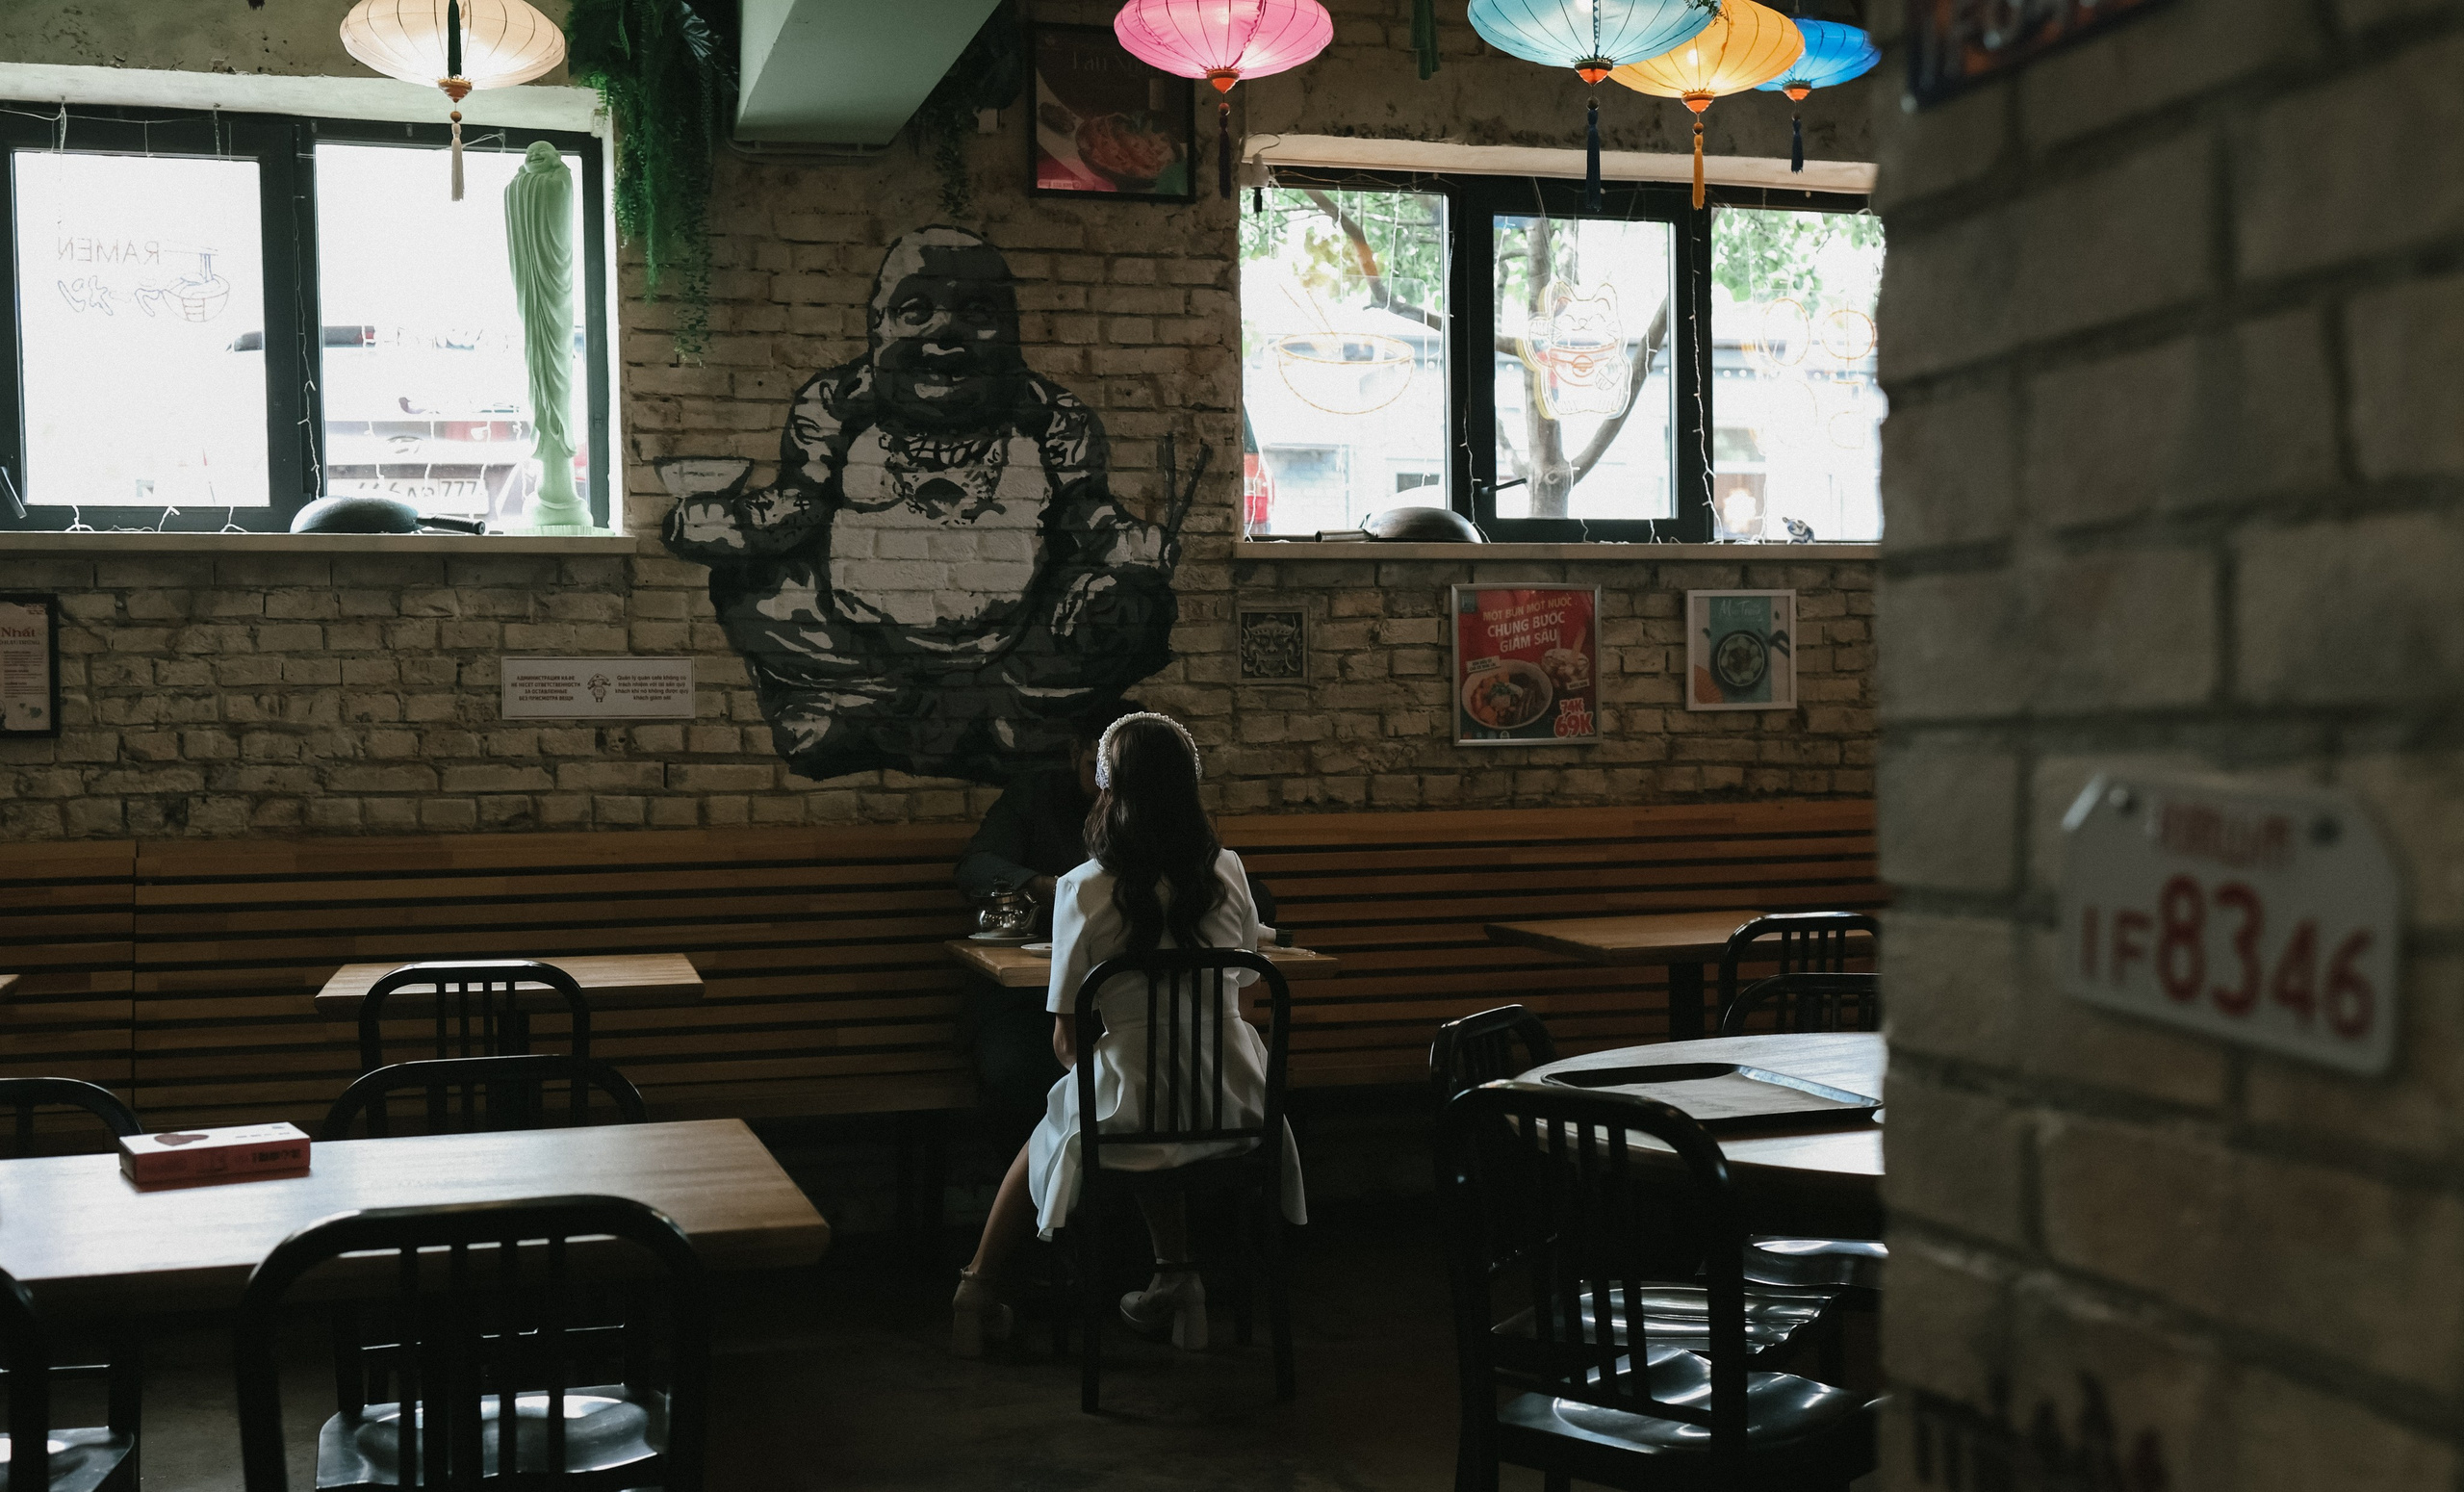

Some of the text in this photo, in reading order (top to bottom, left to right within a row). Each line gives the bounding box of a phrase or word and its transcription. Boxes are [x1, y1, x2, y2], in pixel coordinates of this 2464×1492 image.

[441, 481, 477, 497] 777
[1487, 618, 1529, 637] CHUNG
[1555, 712, 1595, 736] 69K
